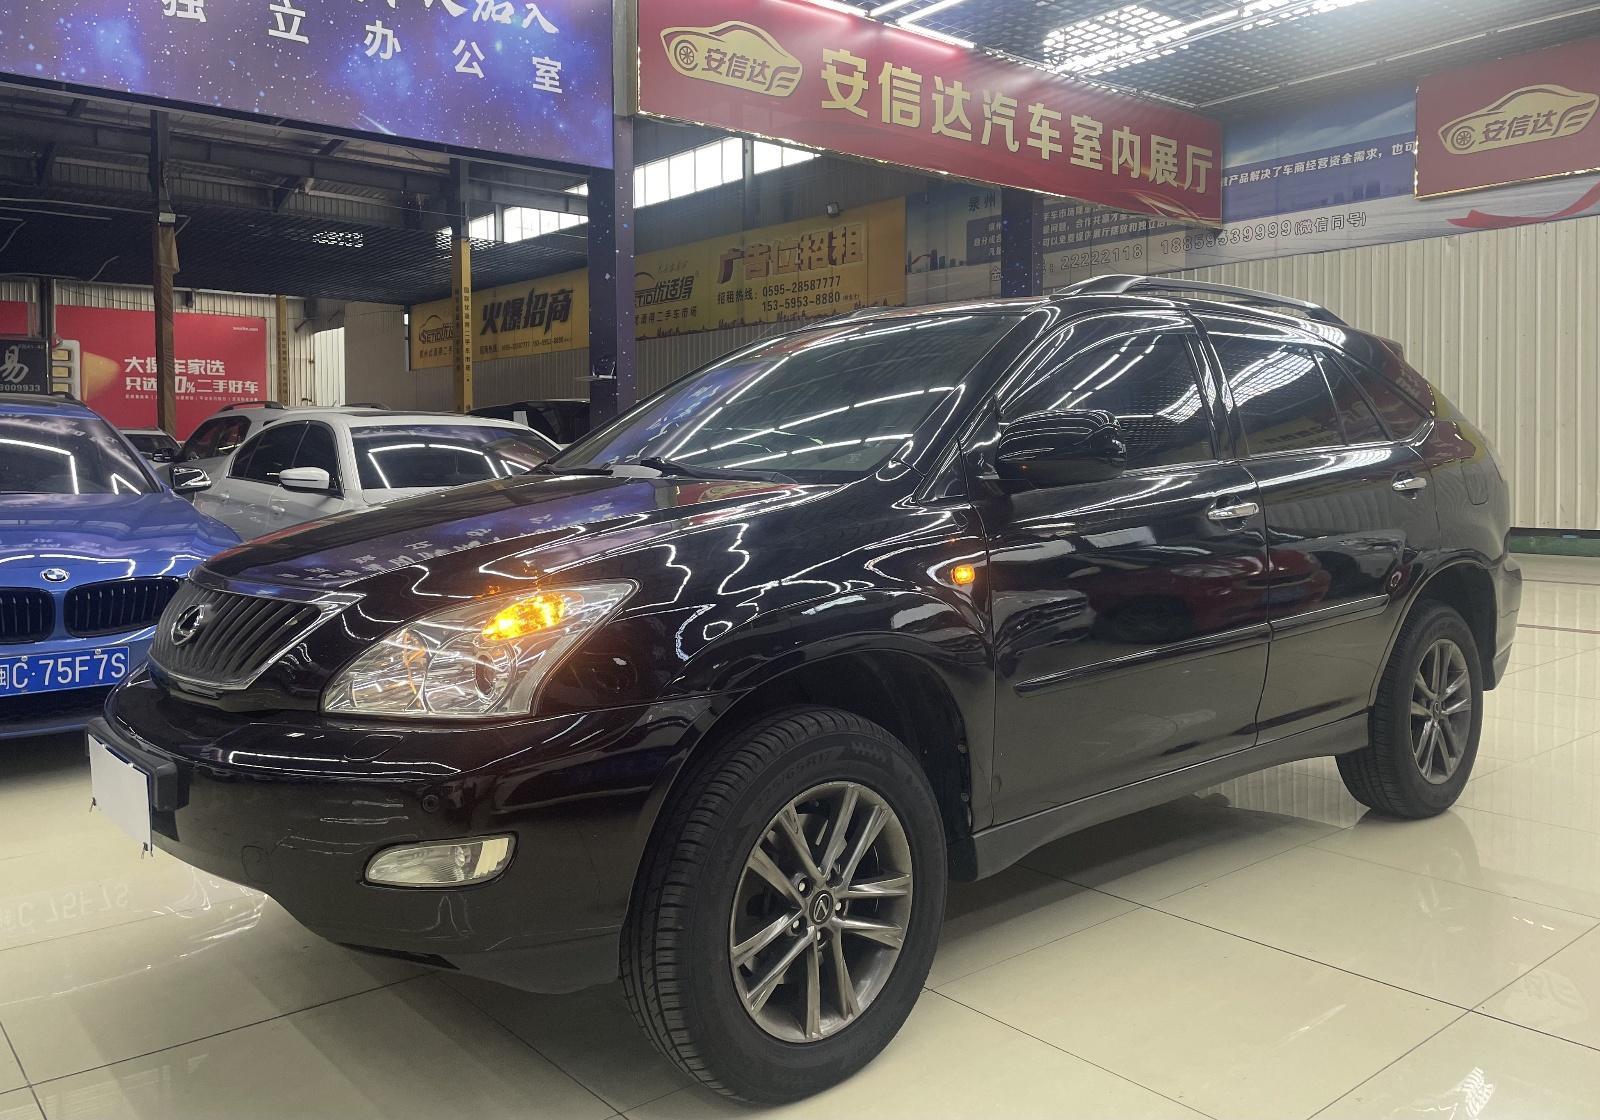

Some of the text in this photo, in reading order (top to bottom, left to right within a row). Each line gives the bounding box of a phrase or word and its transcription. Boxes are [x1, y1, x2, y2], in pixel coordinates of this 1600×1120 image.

[702, 48, 770, 86] 安信达
[820, 47, 1213, 194] 安信达汽车室内展厅
[1478, 109, 1558, 145] 安信达
[716, 223, 864, 285] 广告位招租
[1060, 243, 1143, 270] 22222118
[761, 291, 841, 312] 153-5953-8880
[762, 275, 841, 297] 0595-28587777
[480, 287, 574, 336] 火爆招商
[125, 375, 259, 395] 只选0%二手好车
